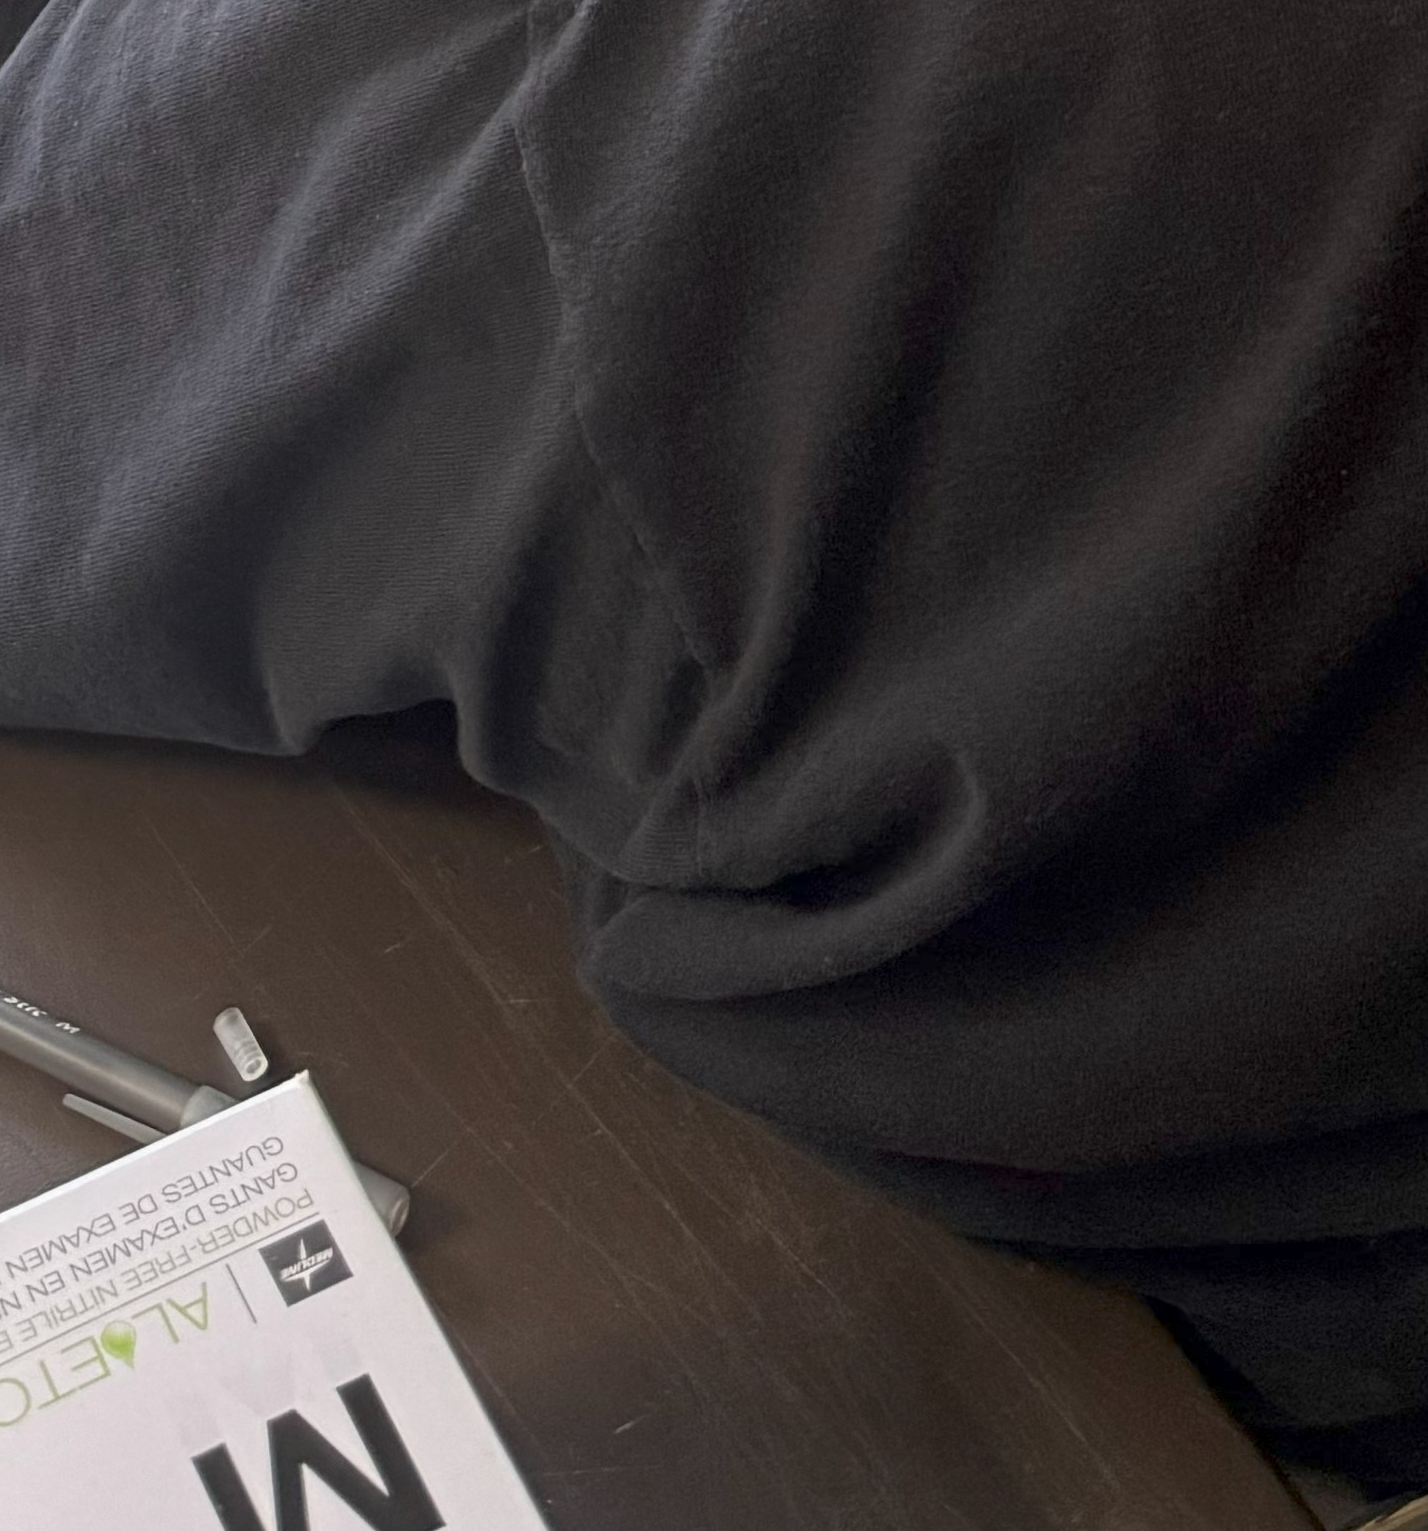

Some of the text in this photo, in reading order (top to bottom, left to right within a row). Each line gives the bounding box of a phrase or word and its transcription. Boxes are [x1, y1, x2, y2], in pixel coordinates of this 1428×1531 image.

[158, 1131, 287, 1208] GUANTES
[205, 1157, 301, 1219] GANTS
[116, 1191, 159, 1226] DE
[118, 1184, 315, 1293] POWDER-FREE
[0, 1211, 118, 1283] EXAMEN
[11, 1276, 121, 1345] NITRILE
[22, 1268, 68, 1305] EN
[191, 1373, 446, 1531] M
